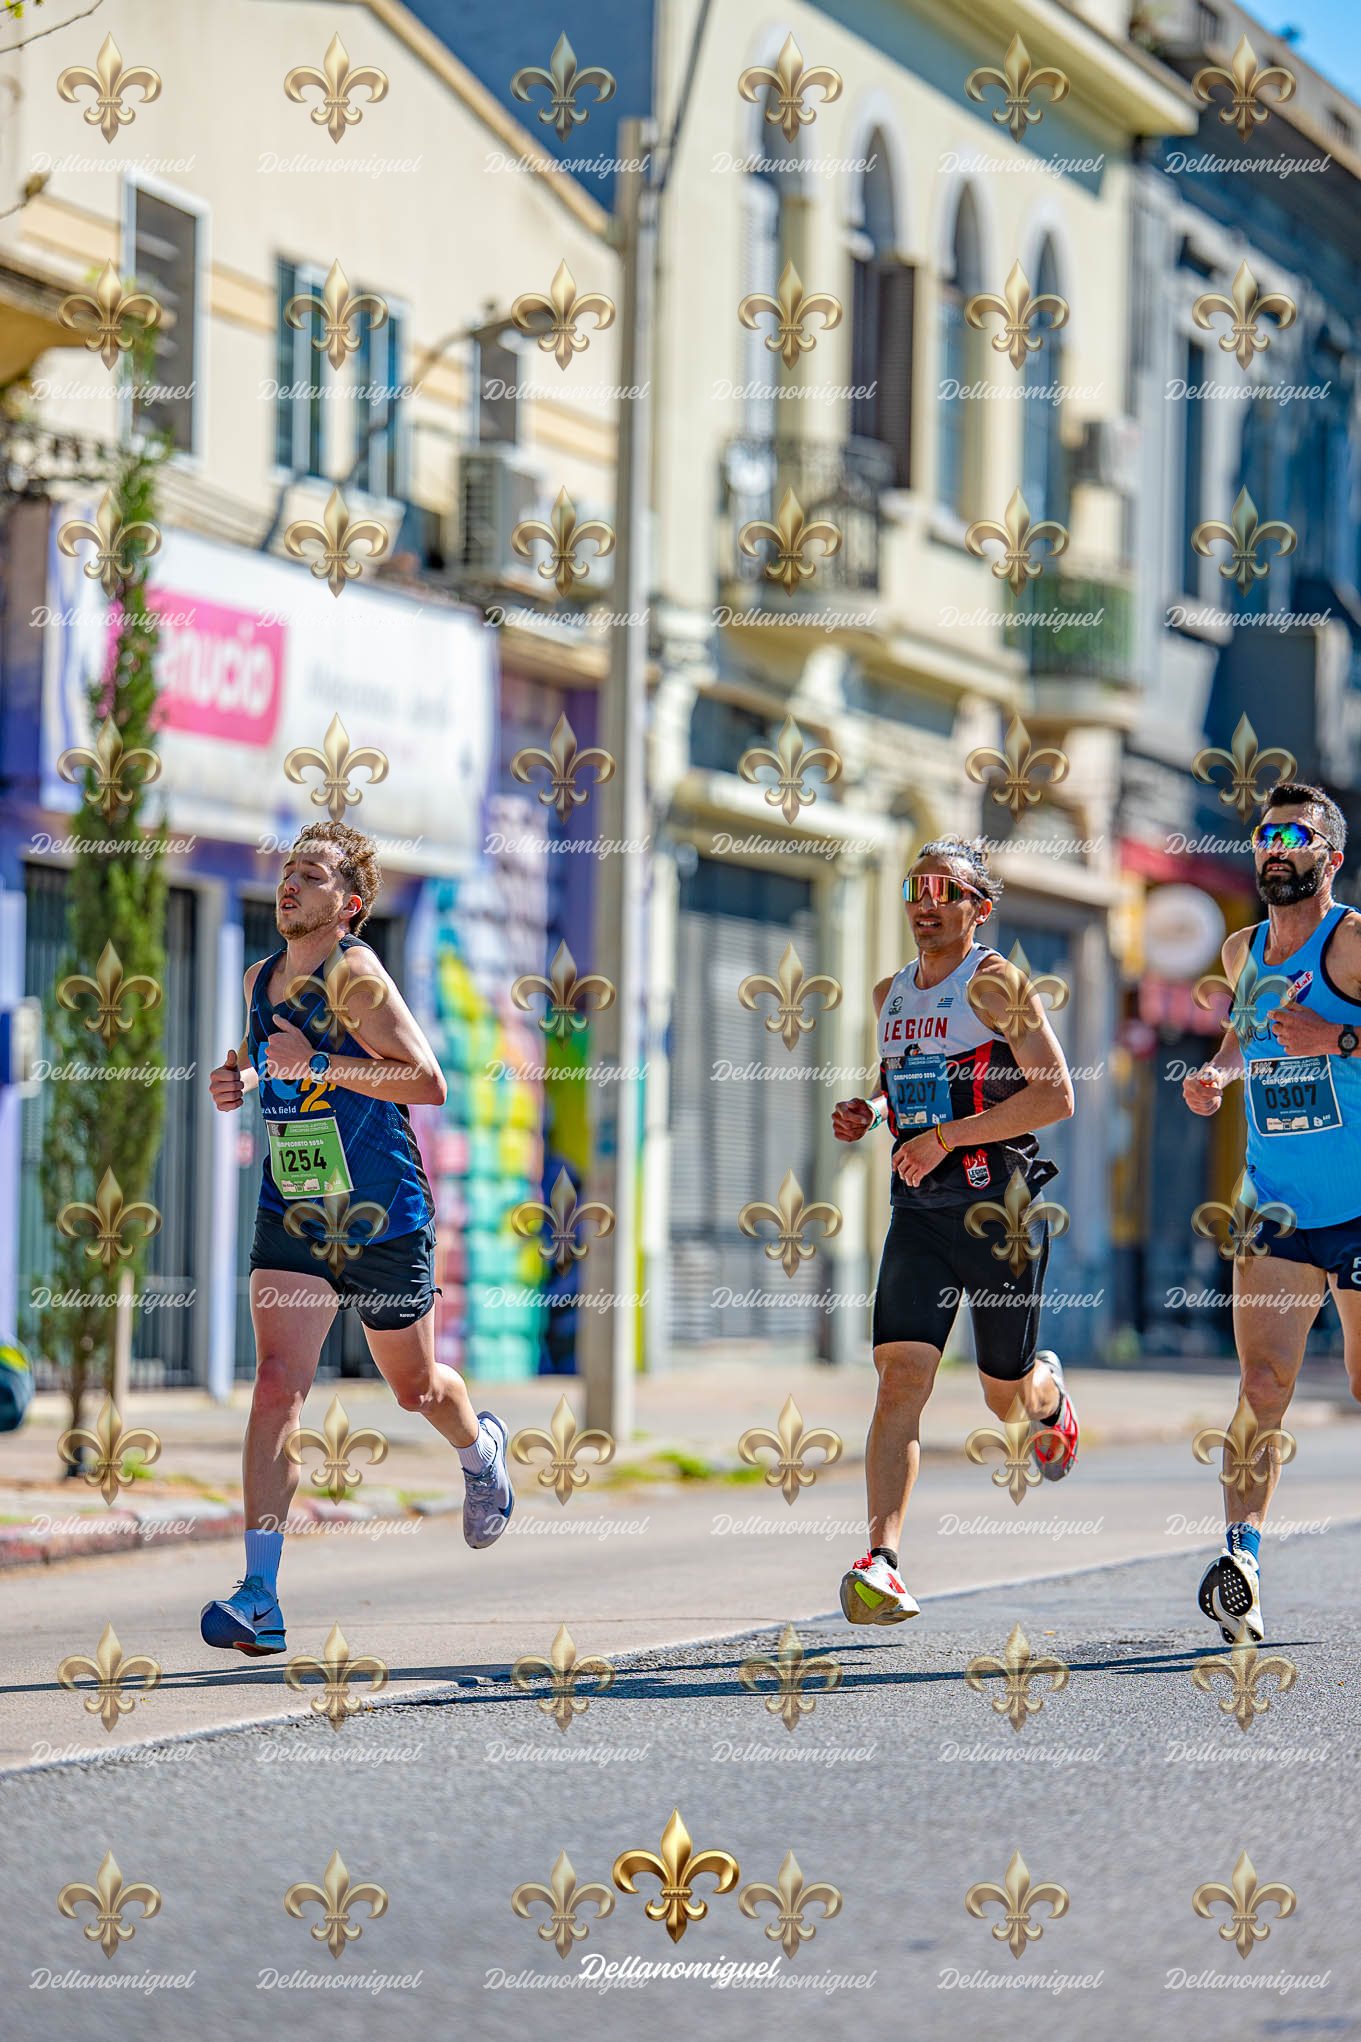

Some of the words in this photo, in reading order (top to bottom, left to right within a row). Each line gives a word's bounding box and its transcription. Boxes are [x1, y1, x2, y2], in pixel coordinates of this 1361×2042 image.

[884, 1017, 948, 1042] LEGION
[896, 1081, 937, 1105] 0207
[1265, 1084, 1317, 1110] 0307
[279, 1148, 328, 1173] 1254
